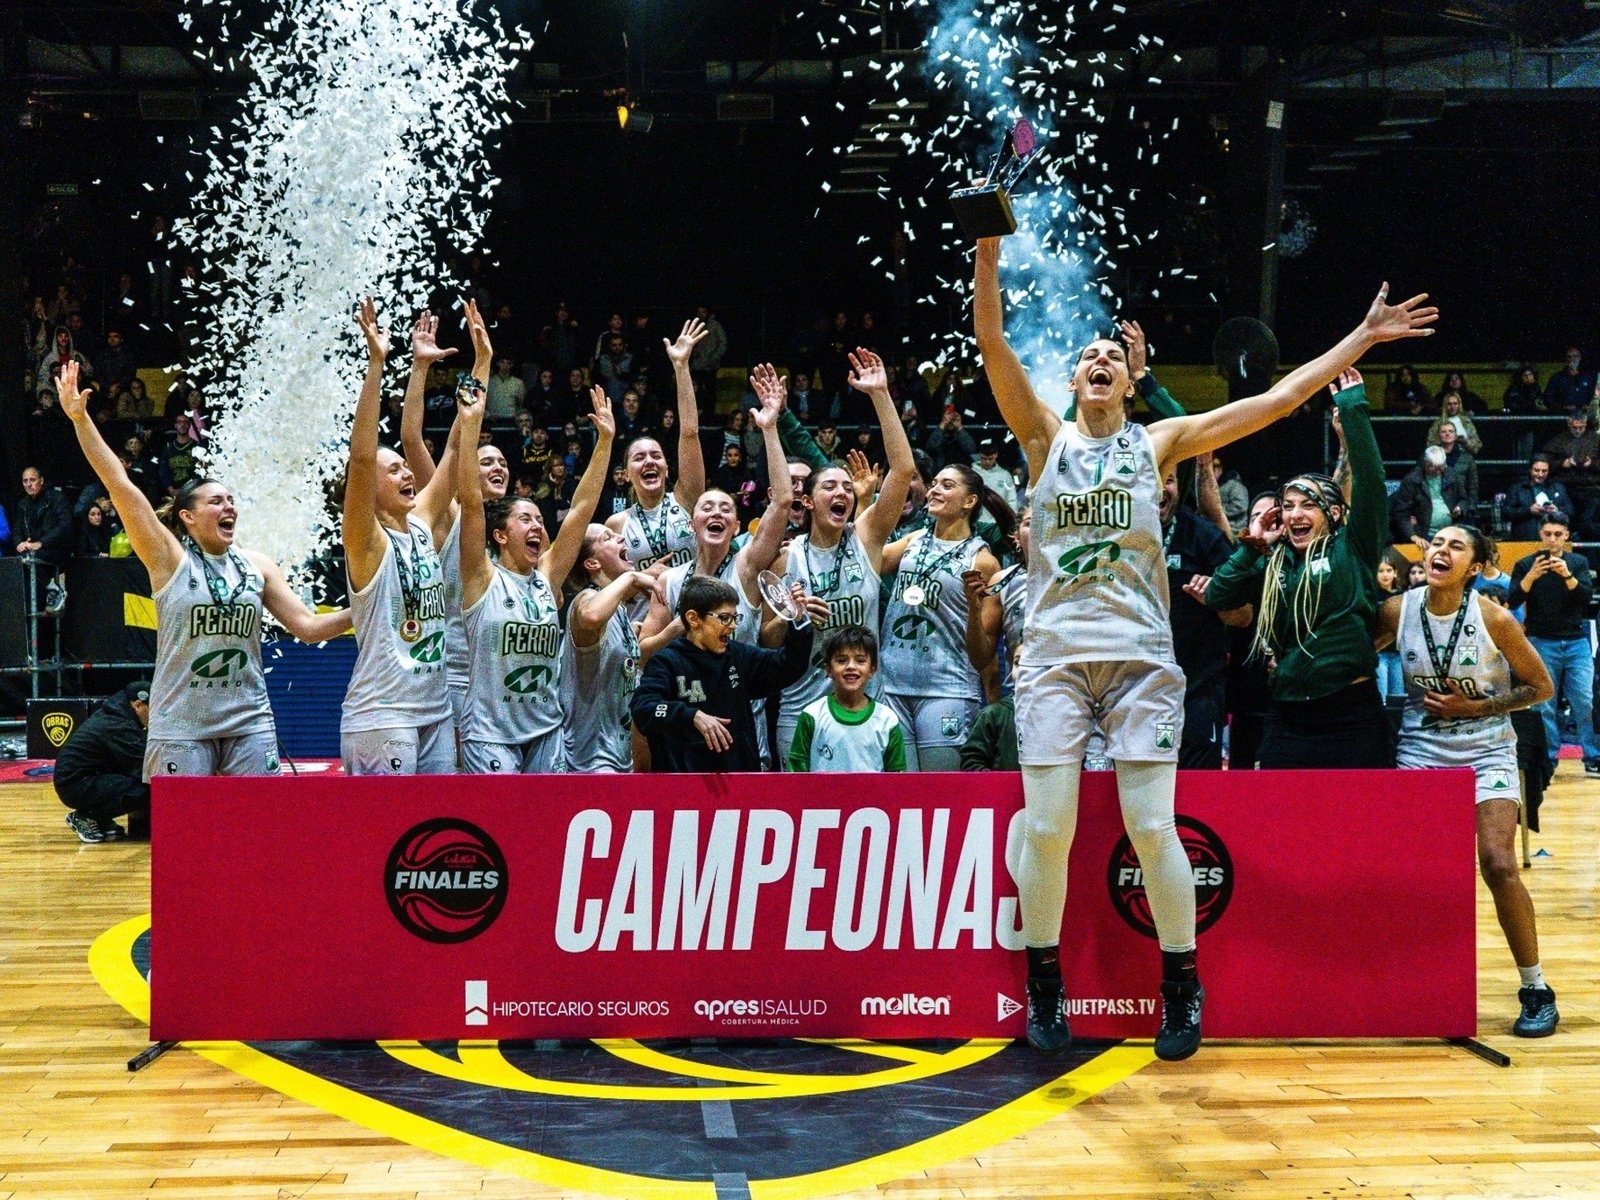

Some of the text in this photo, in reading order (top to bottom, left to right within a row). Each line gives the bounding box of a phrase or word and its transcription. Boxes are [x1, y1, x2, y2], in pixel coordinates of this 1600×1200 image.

[1057, 488, 1132, 531] FERRO
[895, 570, 942, 611] FERO
[190, 603, 257, 639] FERRO
[818, 595, 864, 631] RRO
[502, 621, 558, 659] FERRO
[413, 665, 444, 675] MAR
[189, 680, 243, 689] MARO
[675, 675, 707, 702] LA
[502, 696, 549, 704] MARO
[46, 716, 70, 728] OBRAS
[394, 870, 500, 890] FINALES
[1117, 867, 1225, 887] FIES
[493, 1000, 670, 1017] HIPOTECARIO SEGUROS
[861, 993, 951, 1016] molten
[1062, 998, 1156, 1015] QUETPASS.TV
[770, 1016, 800, 1025] MÉDICA
